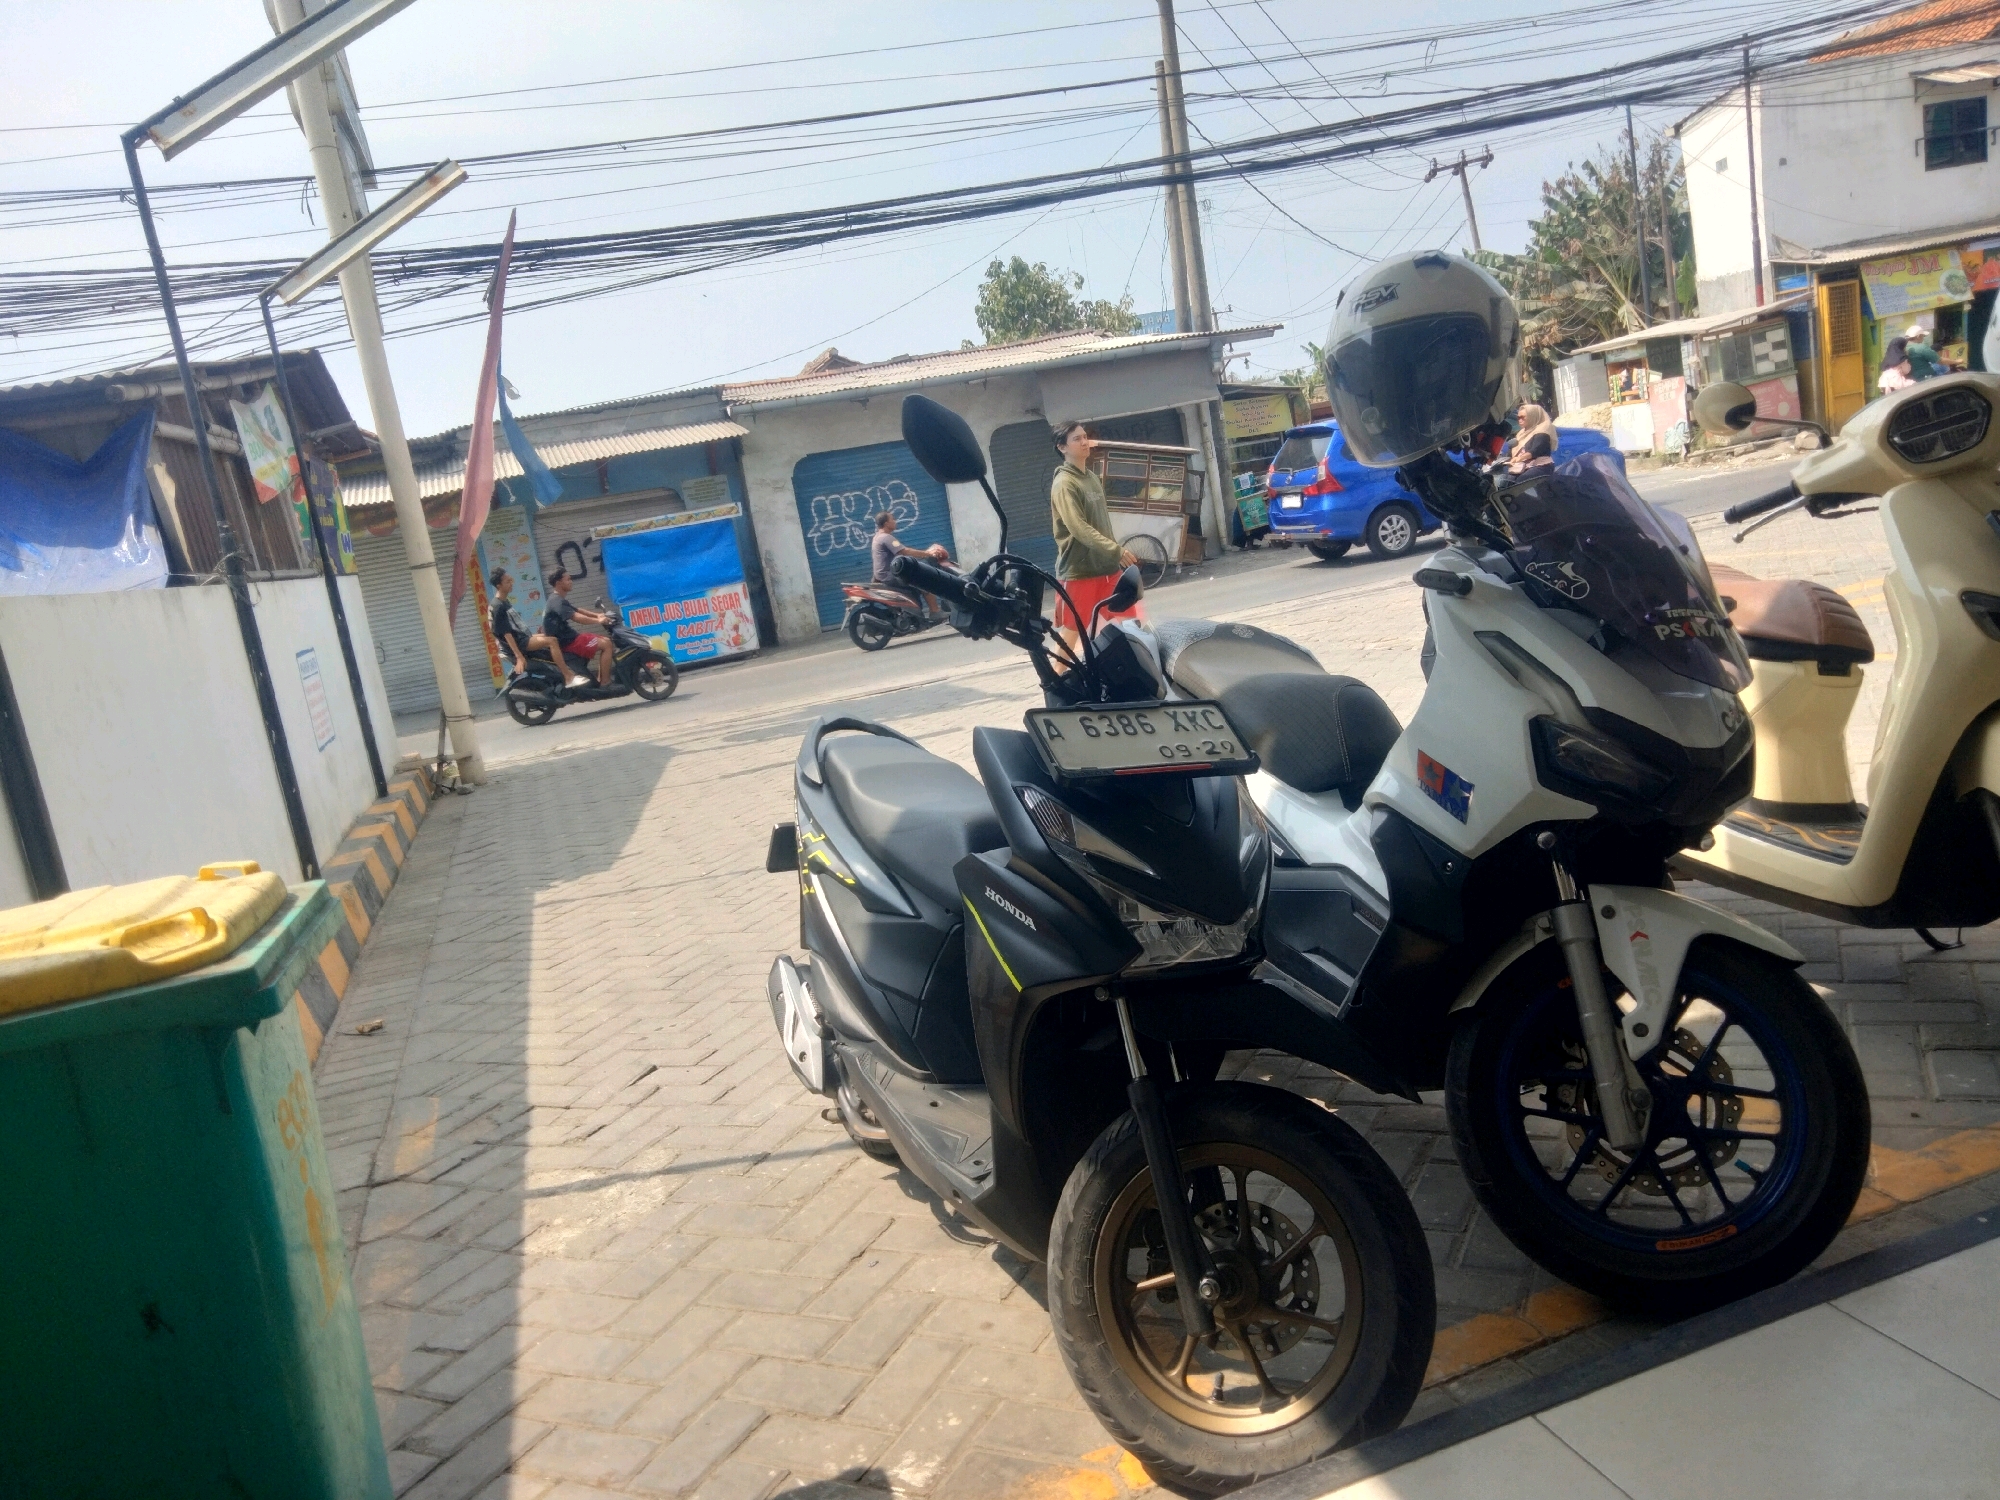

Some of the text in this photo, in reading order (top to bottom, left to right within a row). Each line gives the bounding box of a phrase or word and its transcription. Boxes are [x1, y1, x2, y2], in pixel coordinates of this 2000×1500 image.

[629, 606, 662, 628] ANEKA
[663, 602, 683, 622] JUS
[682, 598, 710, 617] BUAH
[711, 592, 741, 612] SEGAR
[677, 617, 725, 639] KABITA
[1043, 709, 1225, 741] A 6386 XKC
[985, 885, 1037, 931] HONDA
